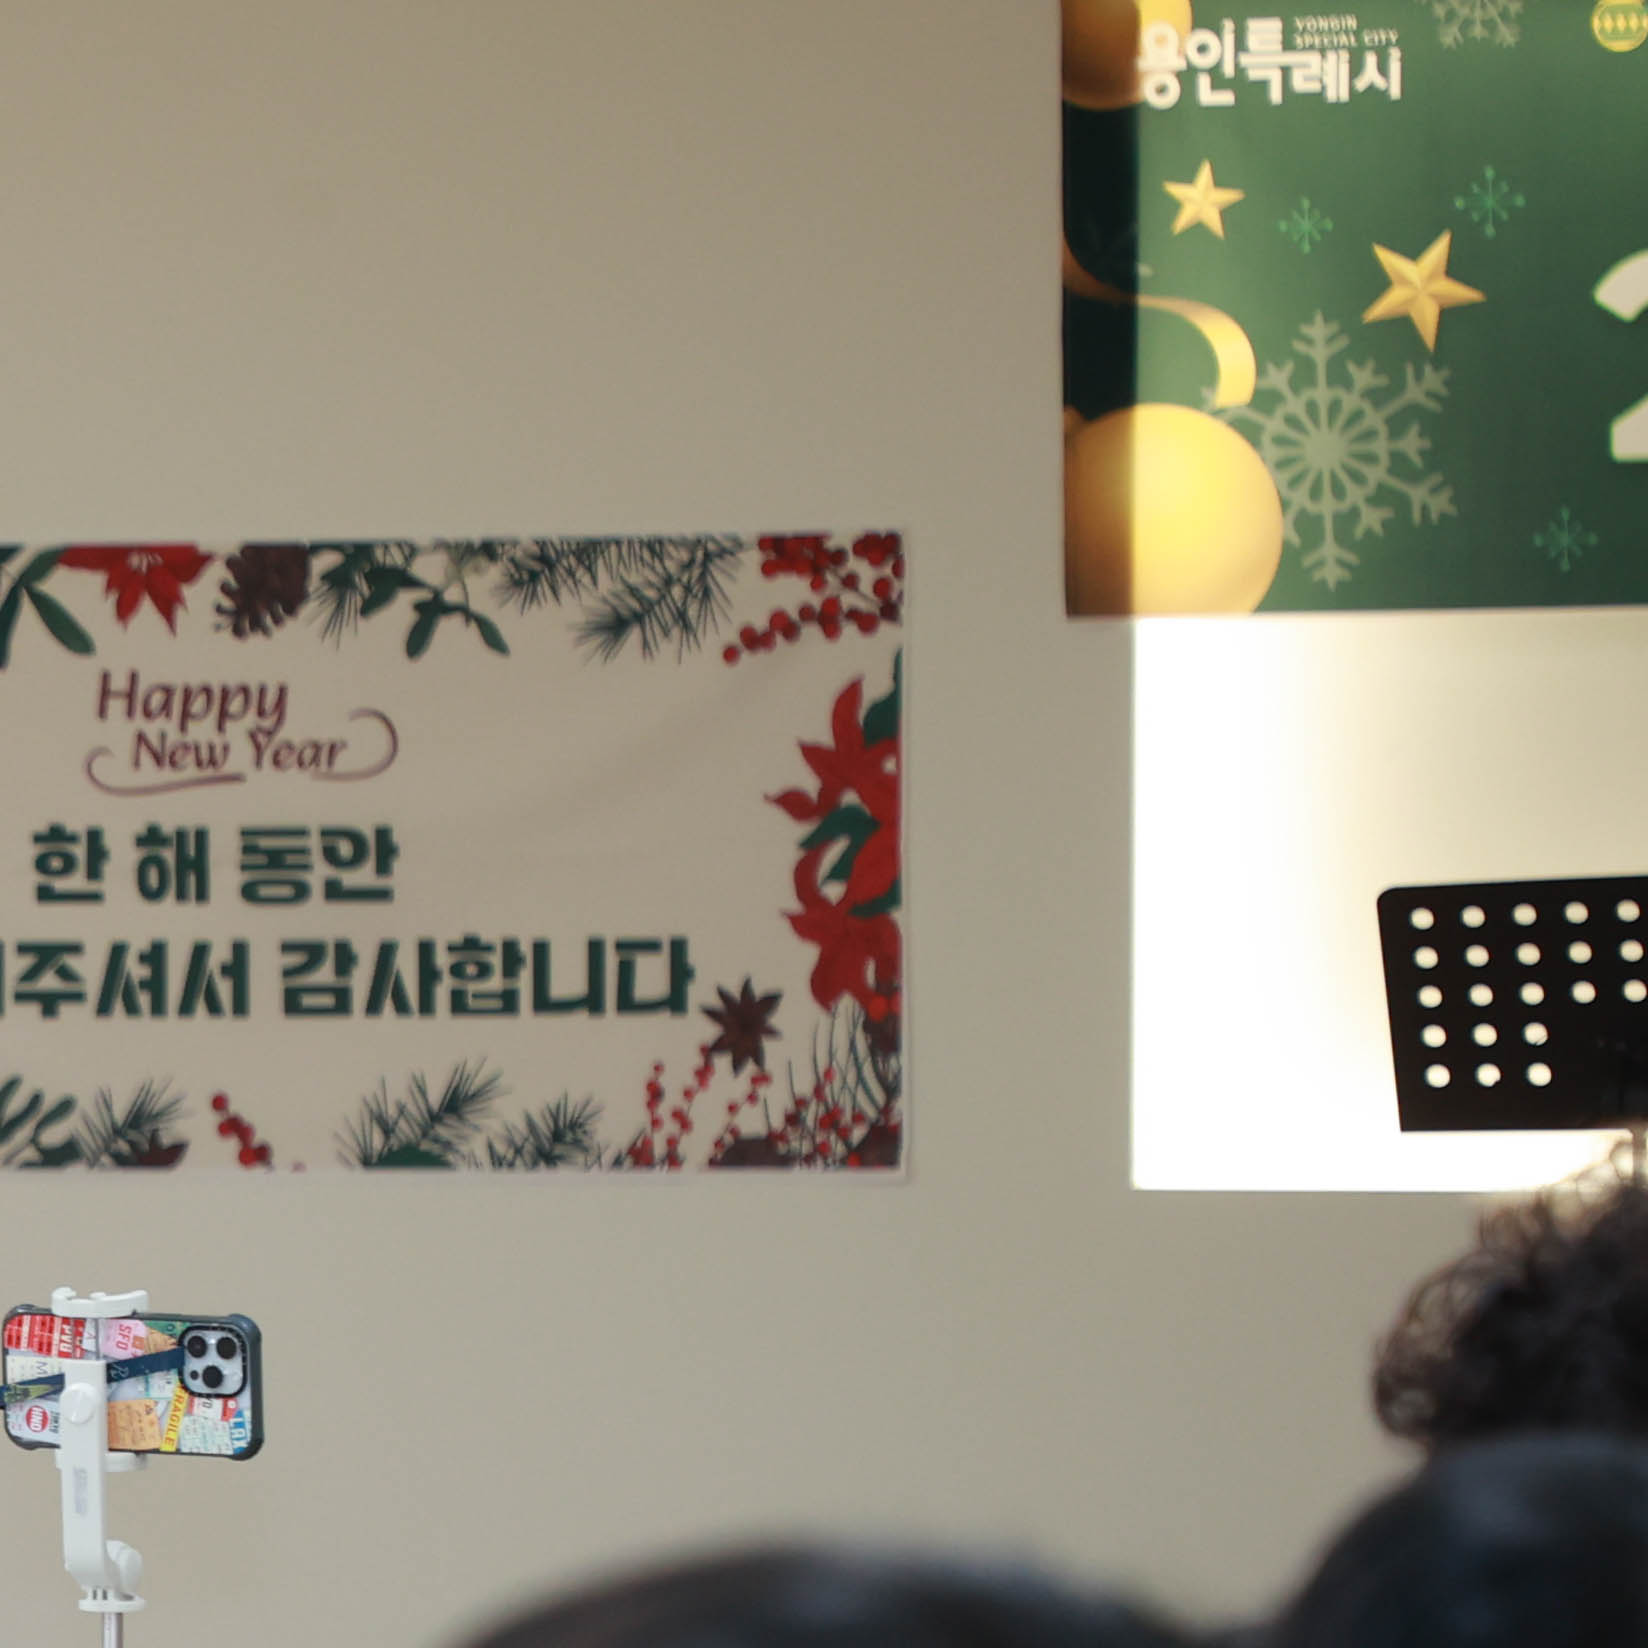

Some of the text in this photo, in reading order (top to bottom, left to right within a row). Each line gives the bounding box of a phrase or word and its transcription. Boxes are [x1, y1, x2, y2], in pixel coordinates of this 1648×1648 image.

[1294, 14, 1357, 33] YONGIN
[1137, 17, 1401, 109] 용인특례시
[98, 669, 288, 735] Happy
[133, 724, 347, 771] New Year
[31, 822, 399, 906] 한 해 동안
[281, 934, 696, 1017] 감사합니다
[115, 1324, 132, 1351] SFO
